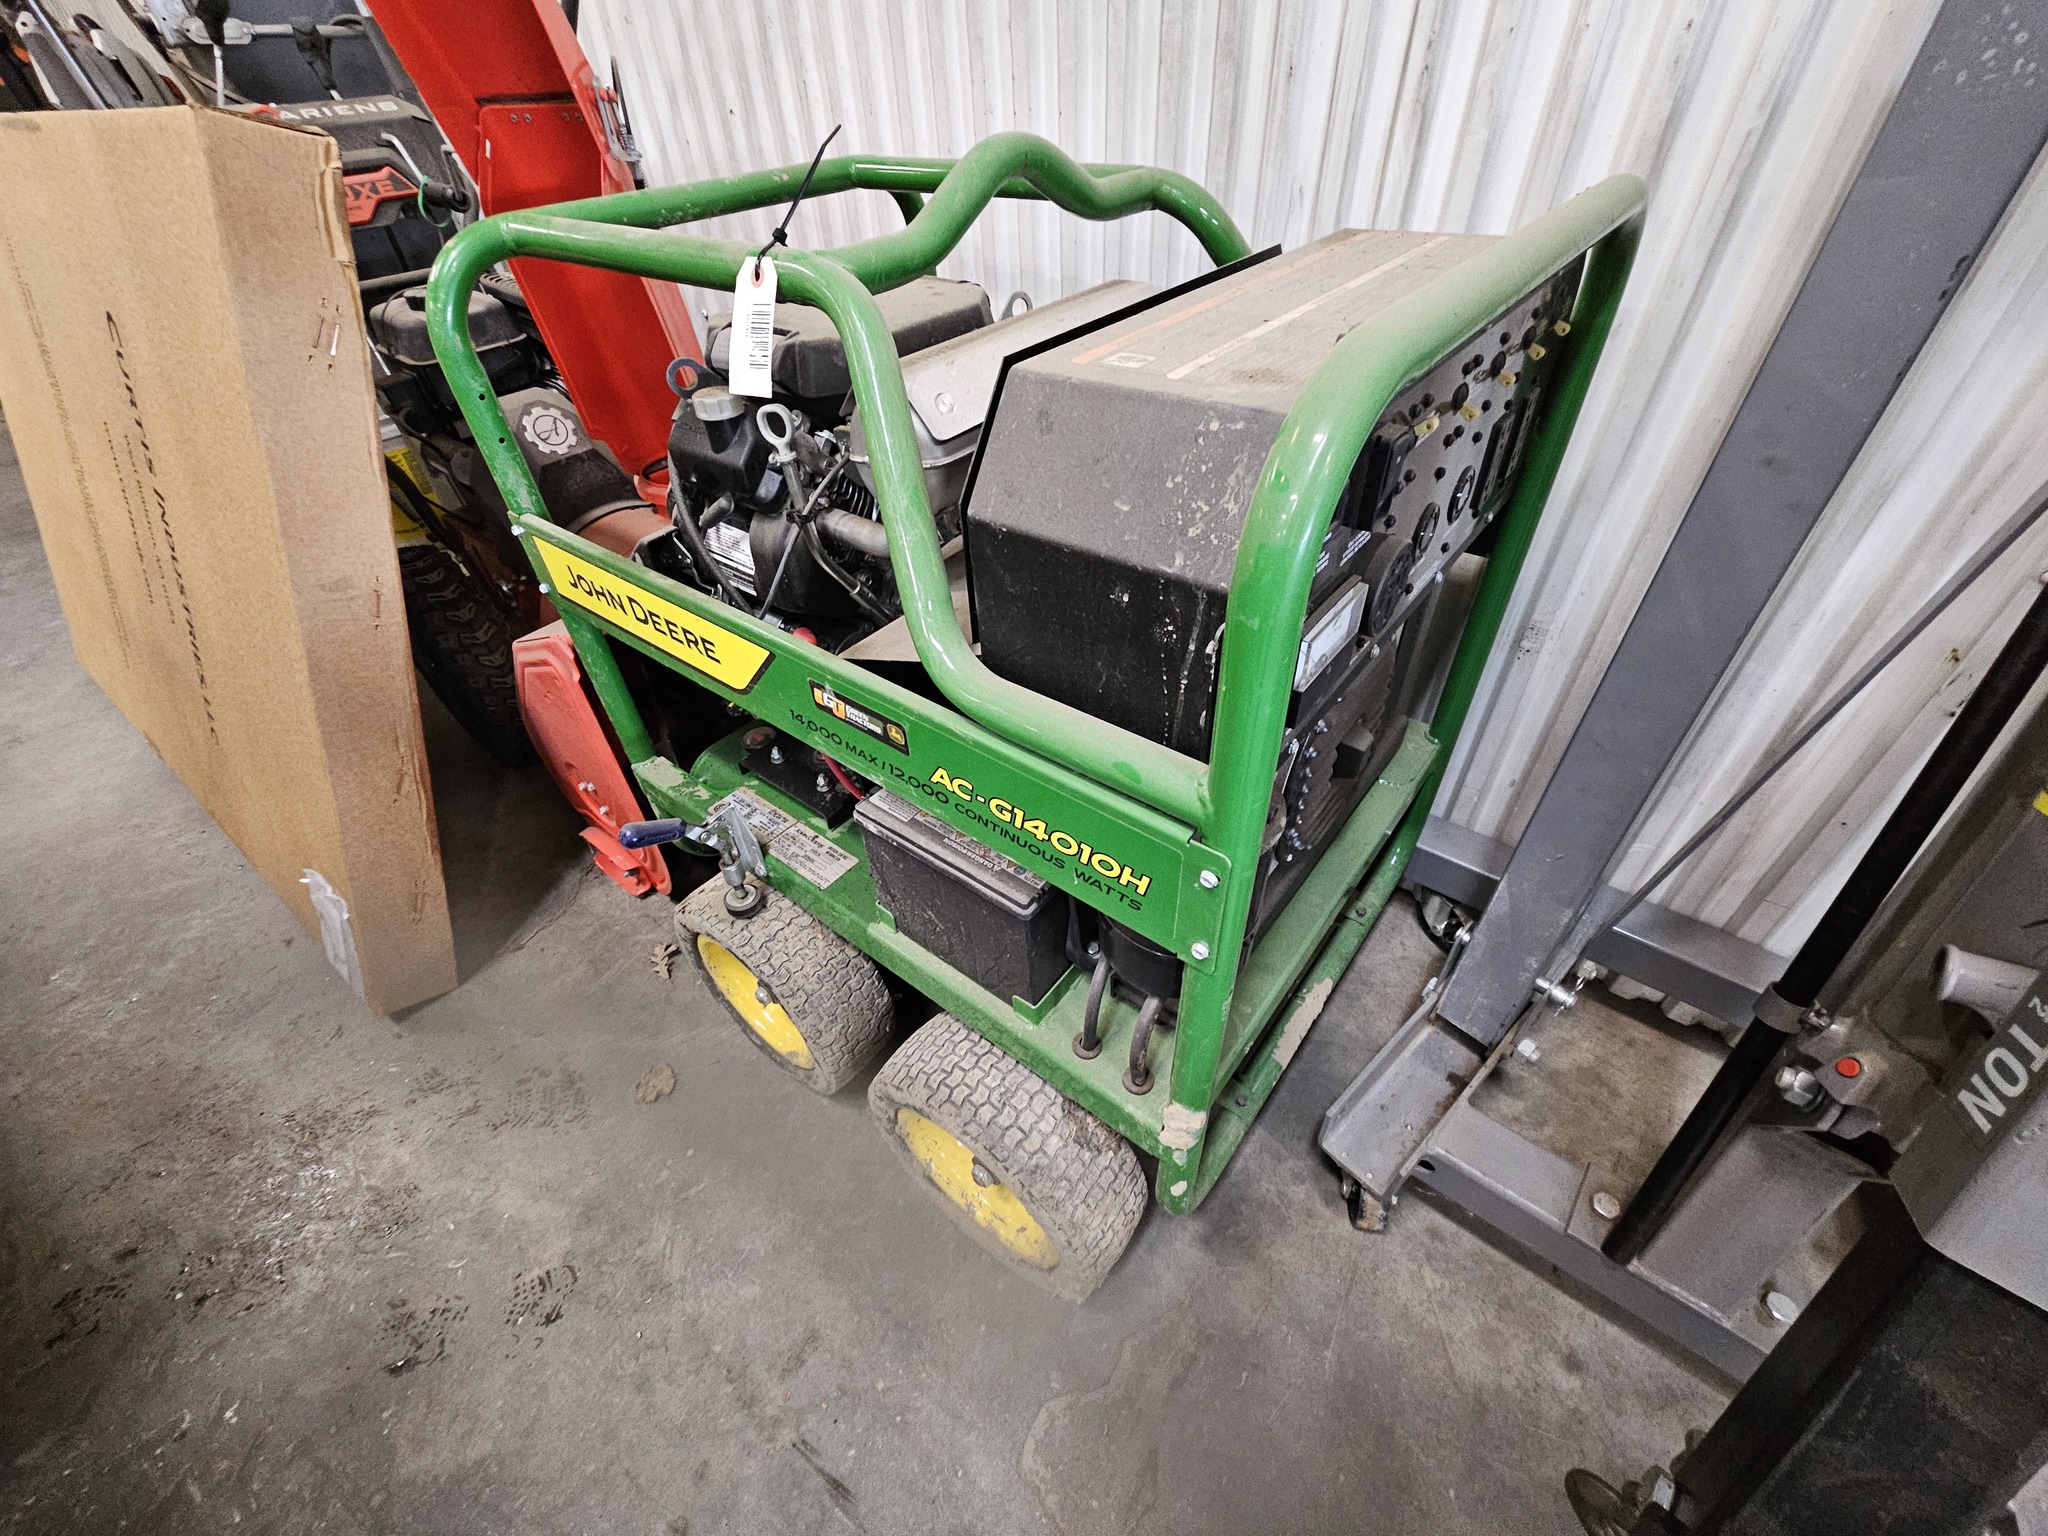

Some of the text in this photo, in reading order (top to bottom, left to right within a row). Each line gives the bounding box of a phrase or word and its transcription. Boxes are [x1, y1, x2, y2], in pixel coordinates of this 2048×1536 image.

[278, 101, 399, 120] ARIENS
[105, 310, 158, 477] CURTIS
[152, 486, 208, 691] INDUSTRIES
[566, 564, 722, 666] JOHN DEERE
[789, 708, 843, 746] 14,000
[845, 741, 879, 767] MAX
[887, 763, 950, 805] 12,000
[954, 802, 1067, 870] CONTINUOUS
[1073, 867, 1144, 912] WATTS
[1956, 1023, 2048, 1135] TON
